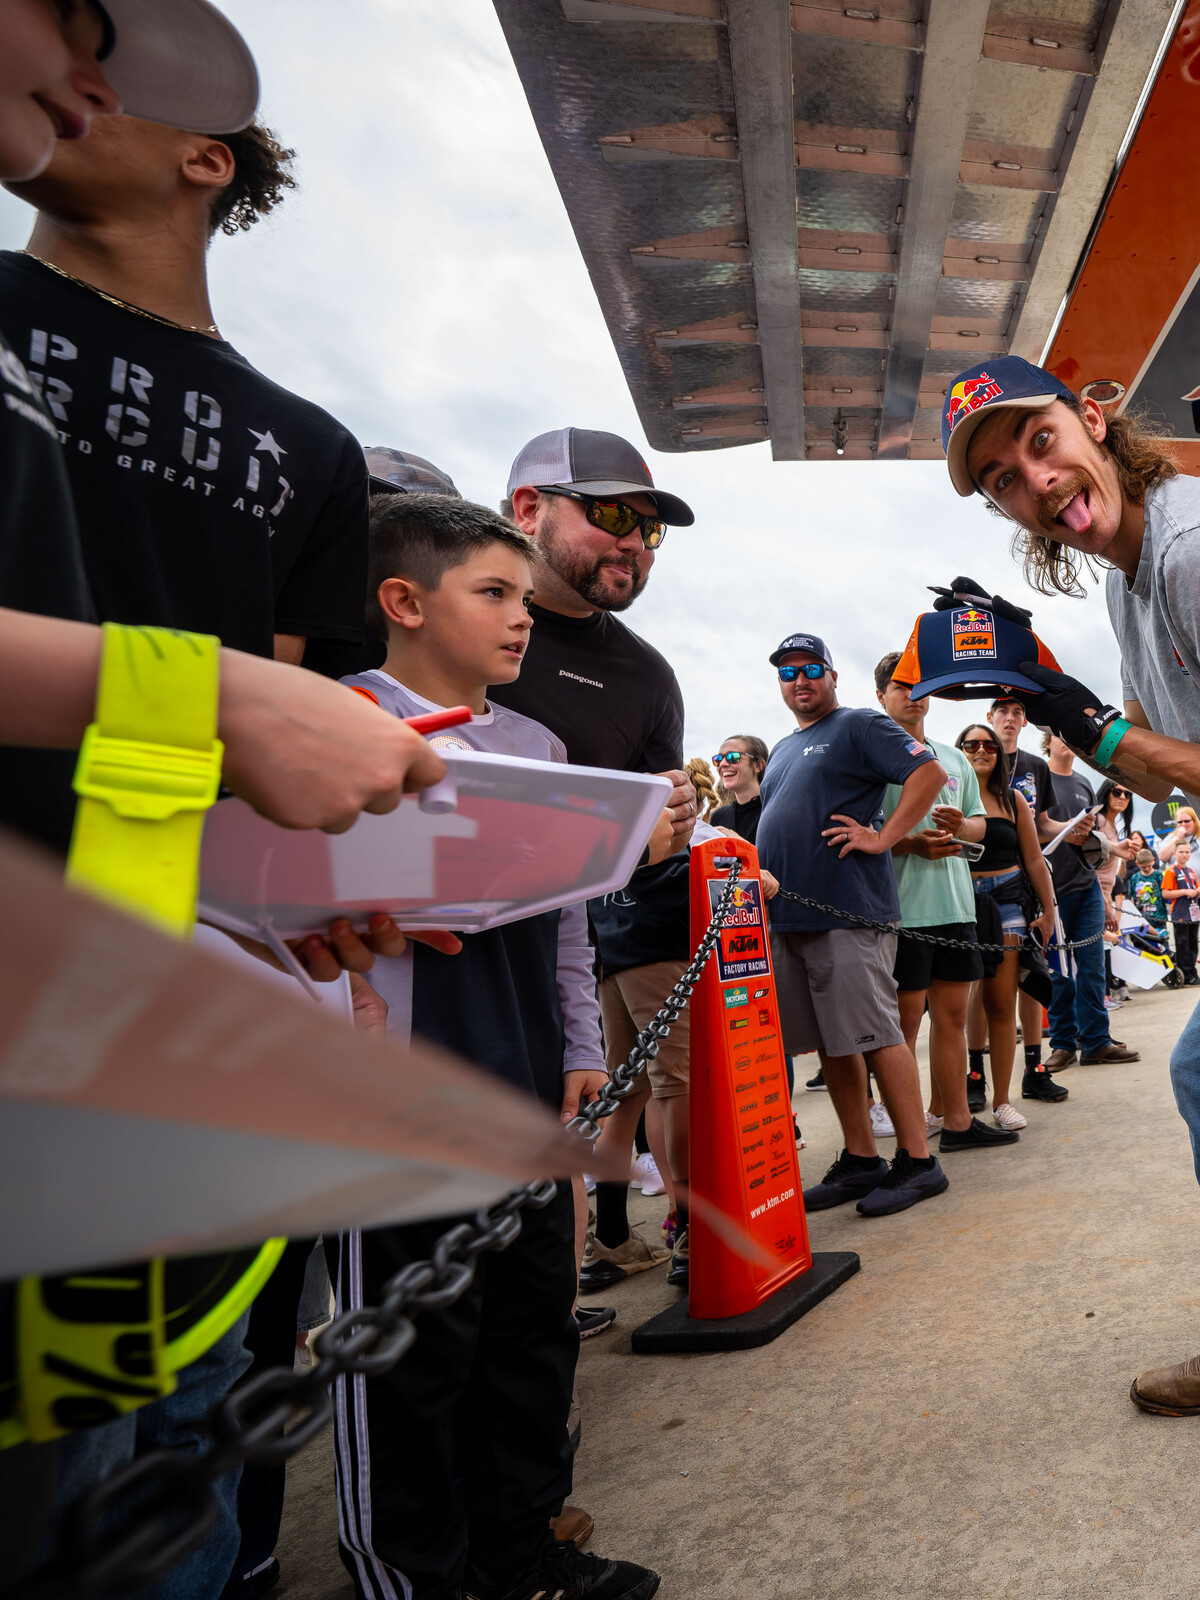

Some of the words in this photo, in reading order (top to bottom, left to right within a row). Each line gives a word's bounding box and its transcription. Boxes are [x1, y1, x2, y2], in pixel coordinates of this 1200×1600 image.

[29, 328, 222, 429] PRO
[969, 383, 1004, 411] Bull
[28, 370, 290, 517] RCUIT
[117, 454, 216, 497] GREAT
[954, 622, 973, 633] Red
[973, 622, 992, 632] Bull
[960, 636, 988, 646] KTM
[955, 650, 977, 658] RACING
[559, 669, 604, 689] patagonia
[723, 908, 740, 926] ed
[740, 907, 760, 925] Bull
[729, 935, 759, 954] KTM
[723, 962, 747, 975] FACTORY
[748, 960, 767, 972] RACING
[750, 1188, 795, 1219] www.ktm.com
